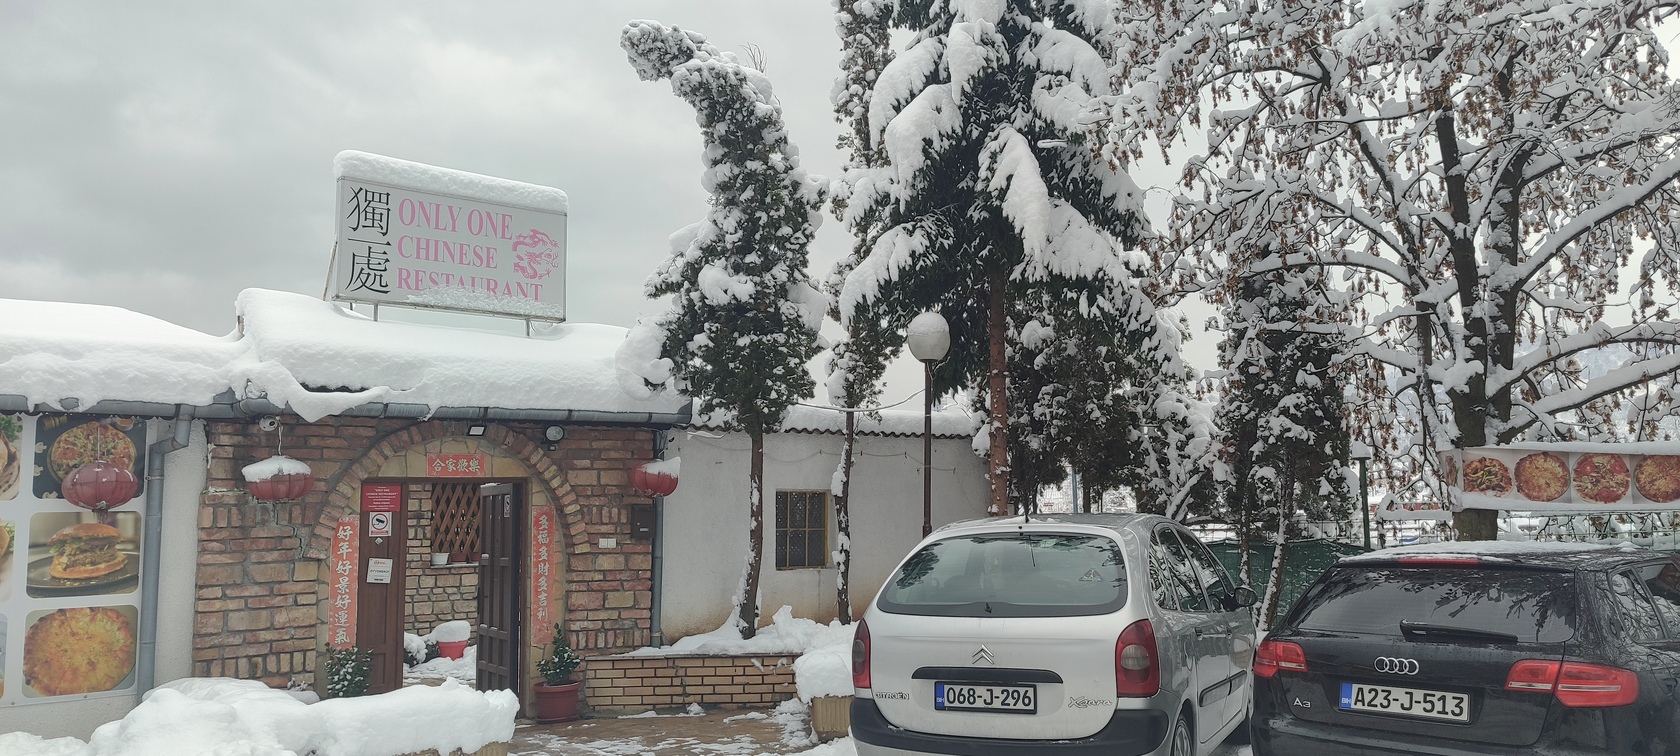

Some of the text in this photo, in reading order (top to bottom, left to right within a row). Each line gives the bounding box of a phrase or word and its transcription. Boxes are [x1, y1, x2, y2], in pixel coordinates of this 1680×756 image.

[398, 198, 513, 240] ONLY ONE
[345, 186, 391, 294] 獨一處
[397, 235, 498, 269] CHINESE
[335, 525, 353, 644] 好年好景好運氣
[537, 514, 550, 621] 多福多財多吉利
[946, 687, 1032, 707] 068-J-296
[1293, 697, 1311, 708] A3
[1354, 687, 1464, 717] A23-J-513
